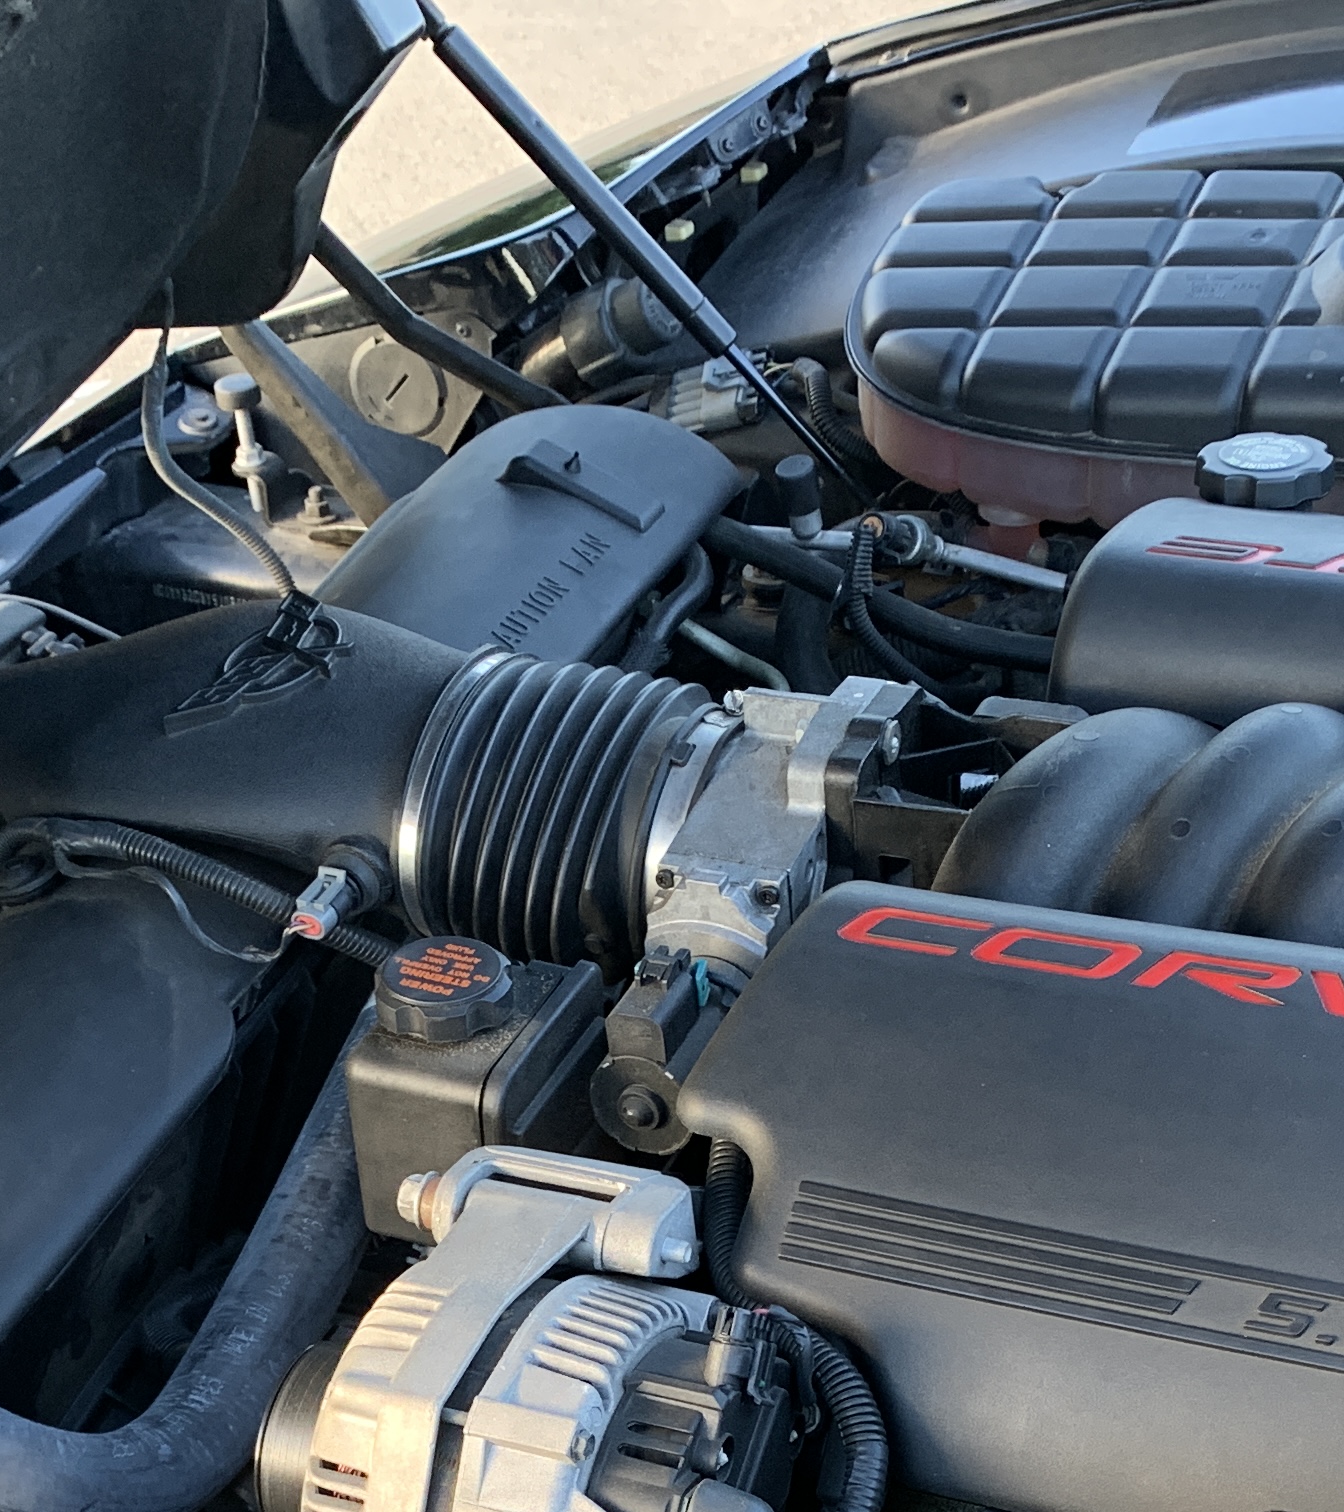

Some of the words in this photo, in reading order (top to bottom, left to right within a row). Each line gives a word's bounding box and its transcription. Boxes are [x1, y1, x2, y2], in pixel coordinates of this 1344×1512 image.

[491, 576, 570, 650] AUTION
[400, 966, 472, 988] STEERING
[447, 969, 470, 978] NOT
[399, 977, 454, 996] POWER
